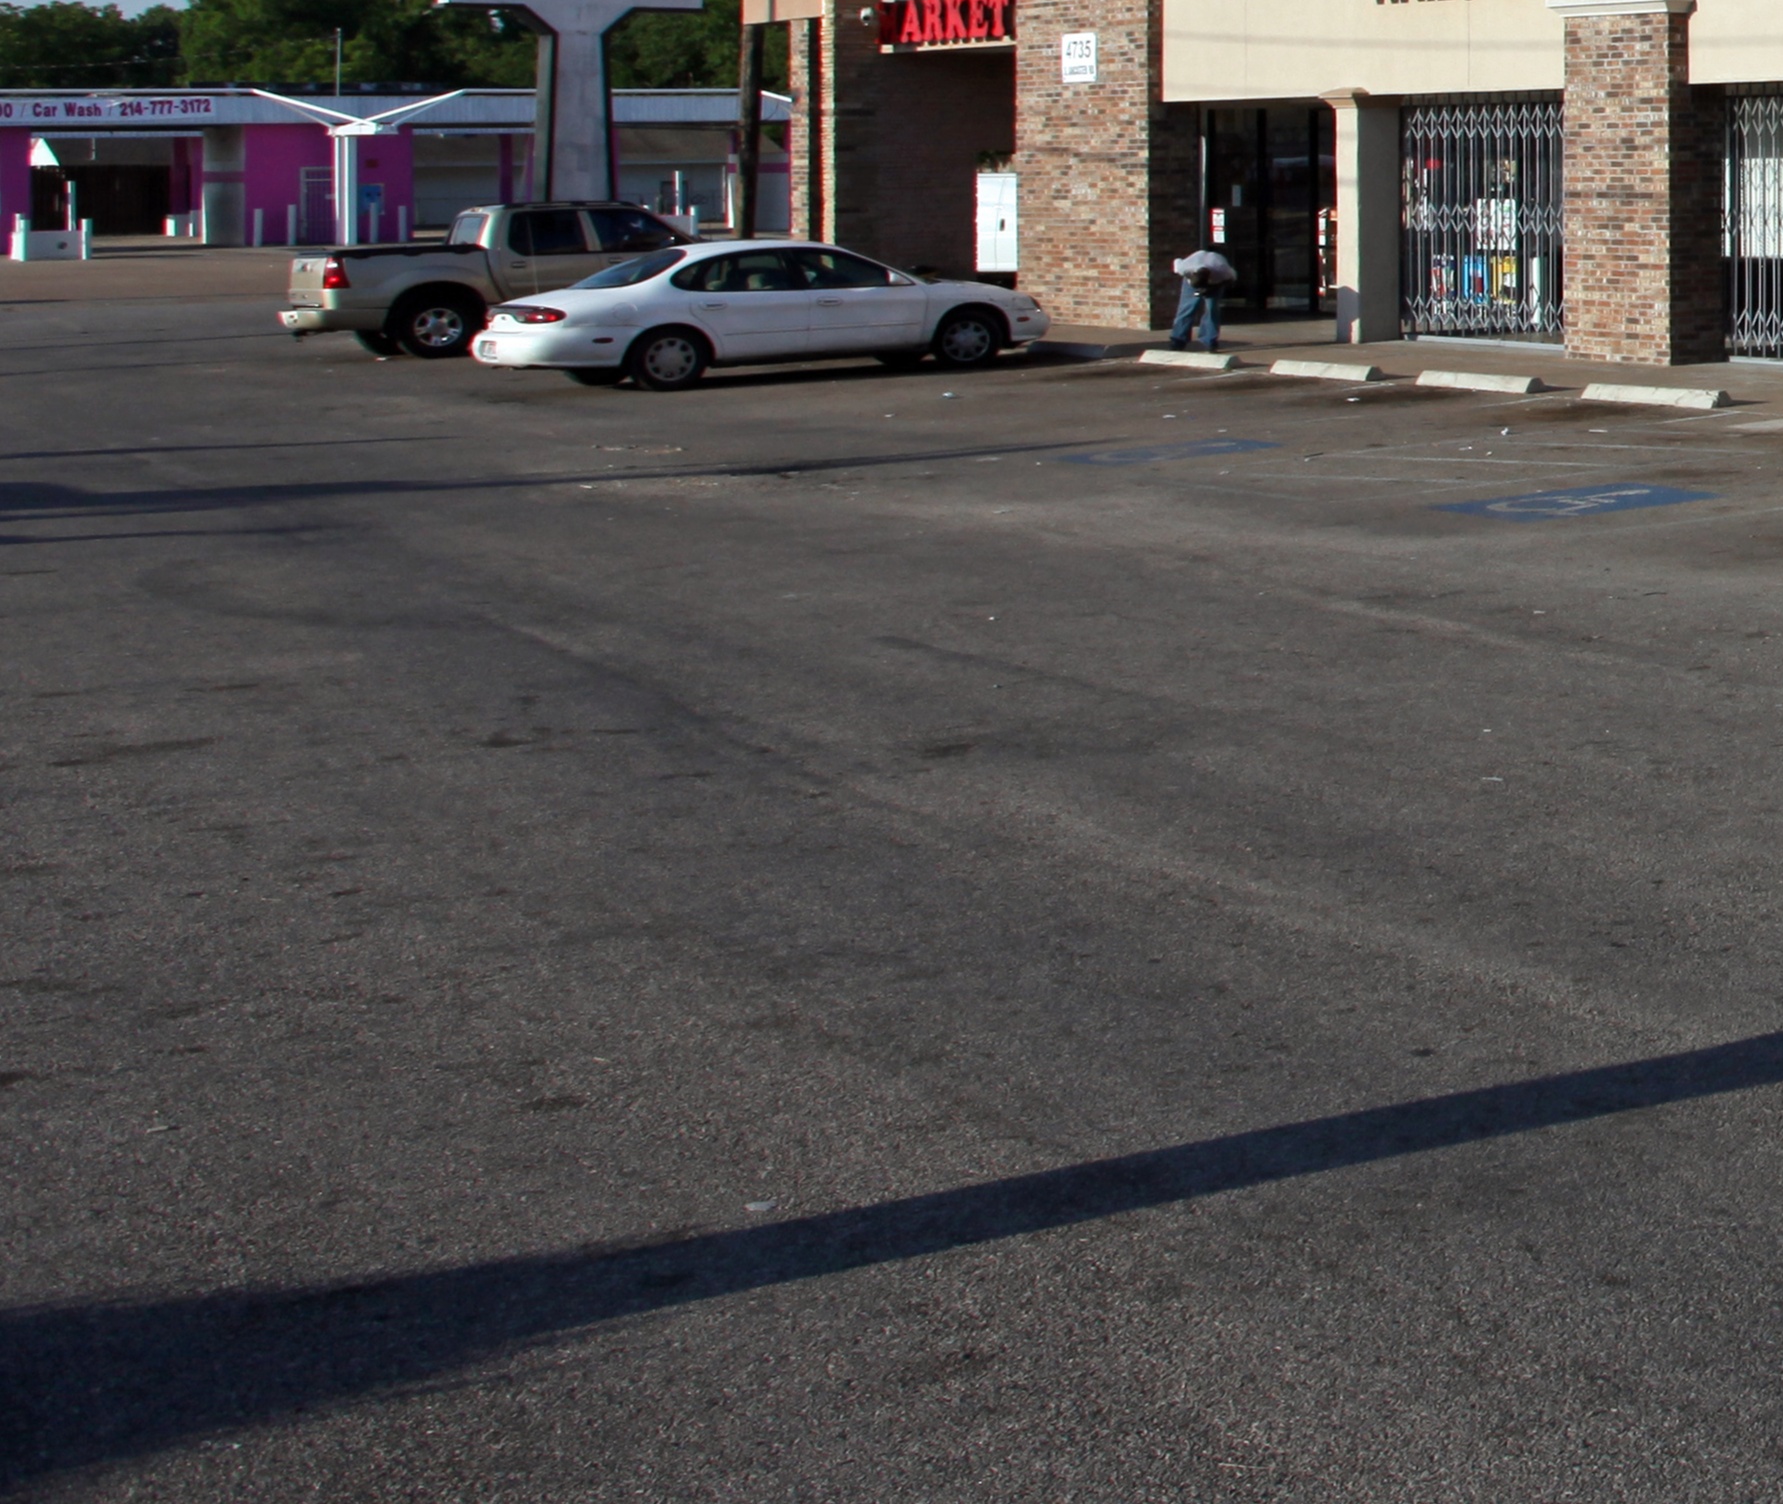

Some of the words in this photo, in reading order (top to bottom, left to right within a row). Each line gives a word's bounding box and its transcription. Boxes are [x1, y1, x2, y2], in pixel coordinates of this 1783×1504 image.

[1065, 40, 1092, 58] 4735
[32, 102, 57, 117] Car
[63, 102, 103, 117] Wash
[119, 98, 212, 117] 214-777-3172
